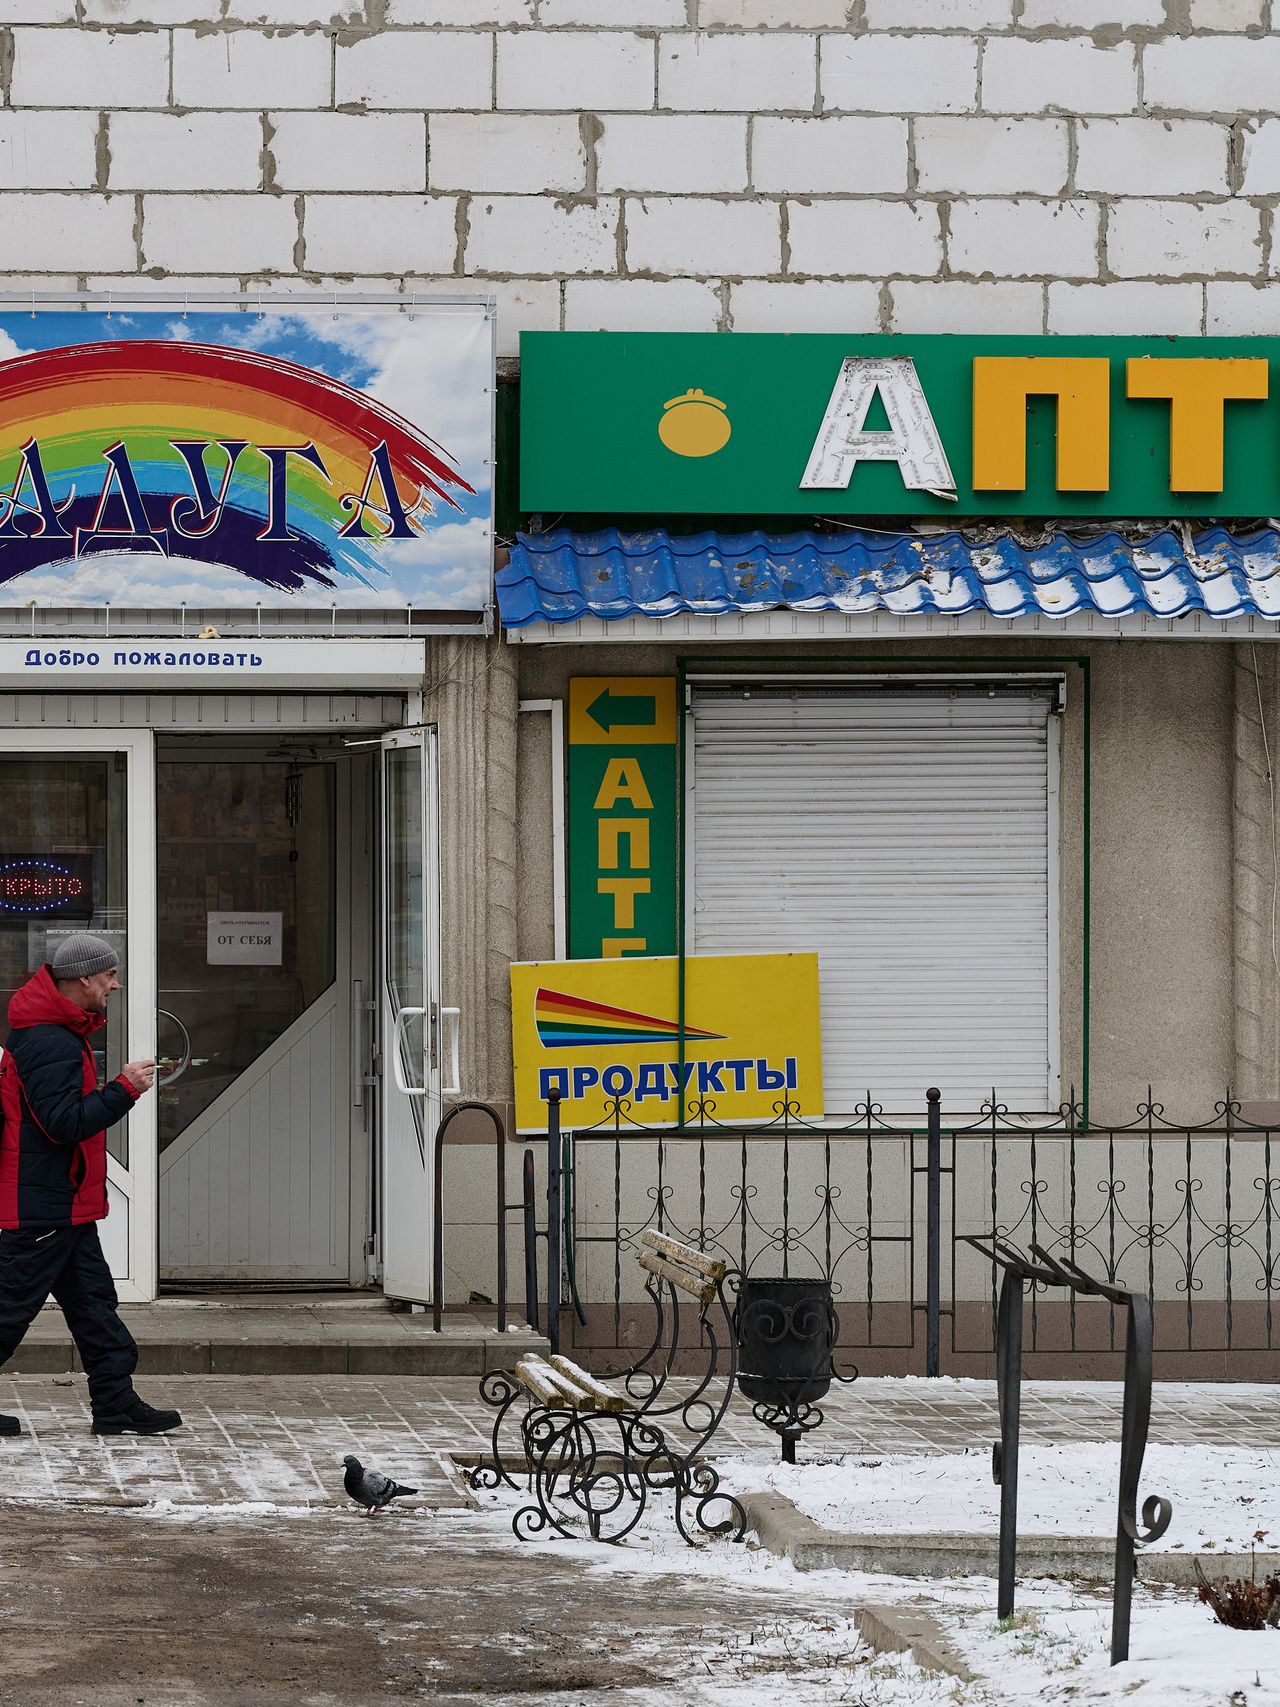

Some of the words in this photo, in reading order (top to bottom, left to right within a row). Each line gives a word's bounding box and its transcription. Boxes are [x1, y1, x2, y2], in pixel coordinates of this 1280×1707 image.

[24, 649, 100, 667] Добро
[113, 650, 263, 667] пожаловать
[217, 935, 235, 945] ОТ
[240, 935, 272, 946] СЕБЯ
[538, 1057, 798, 1103] ПРОДУКТЫ
